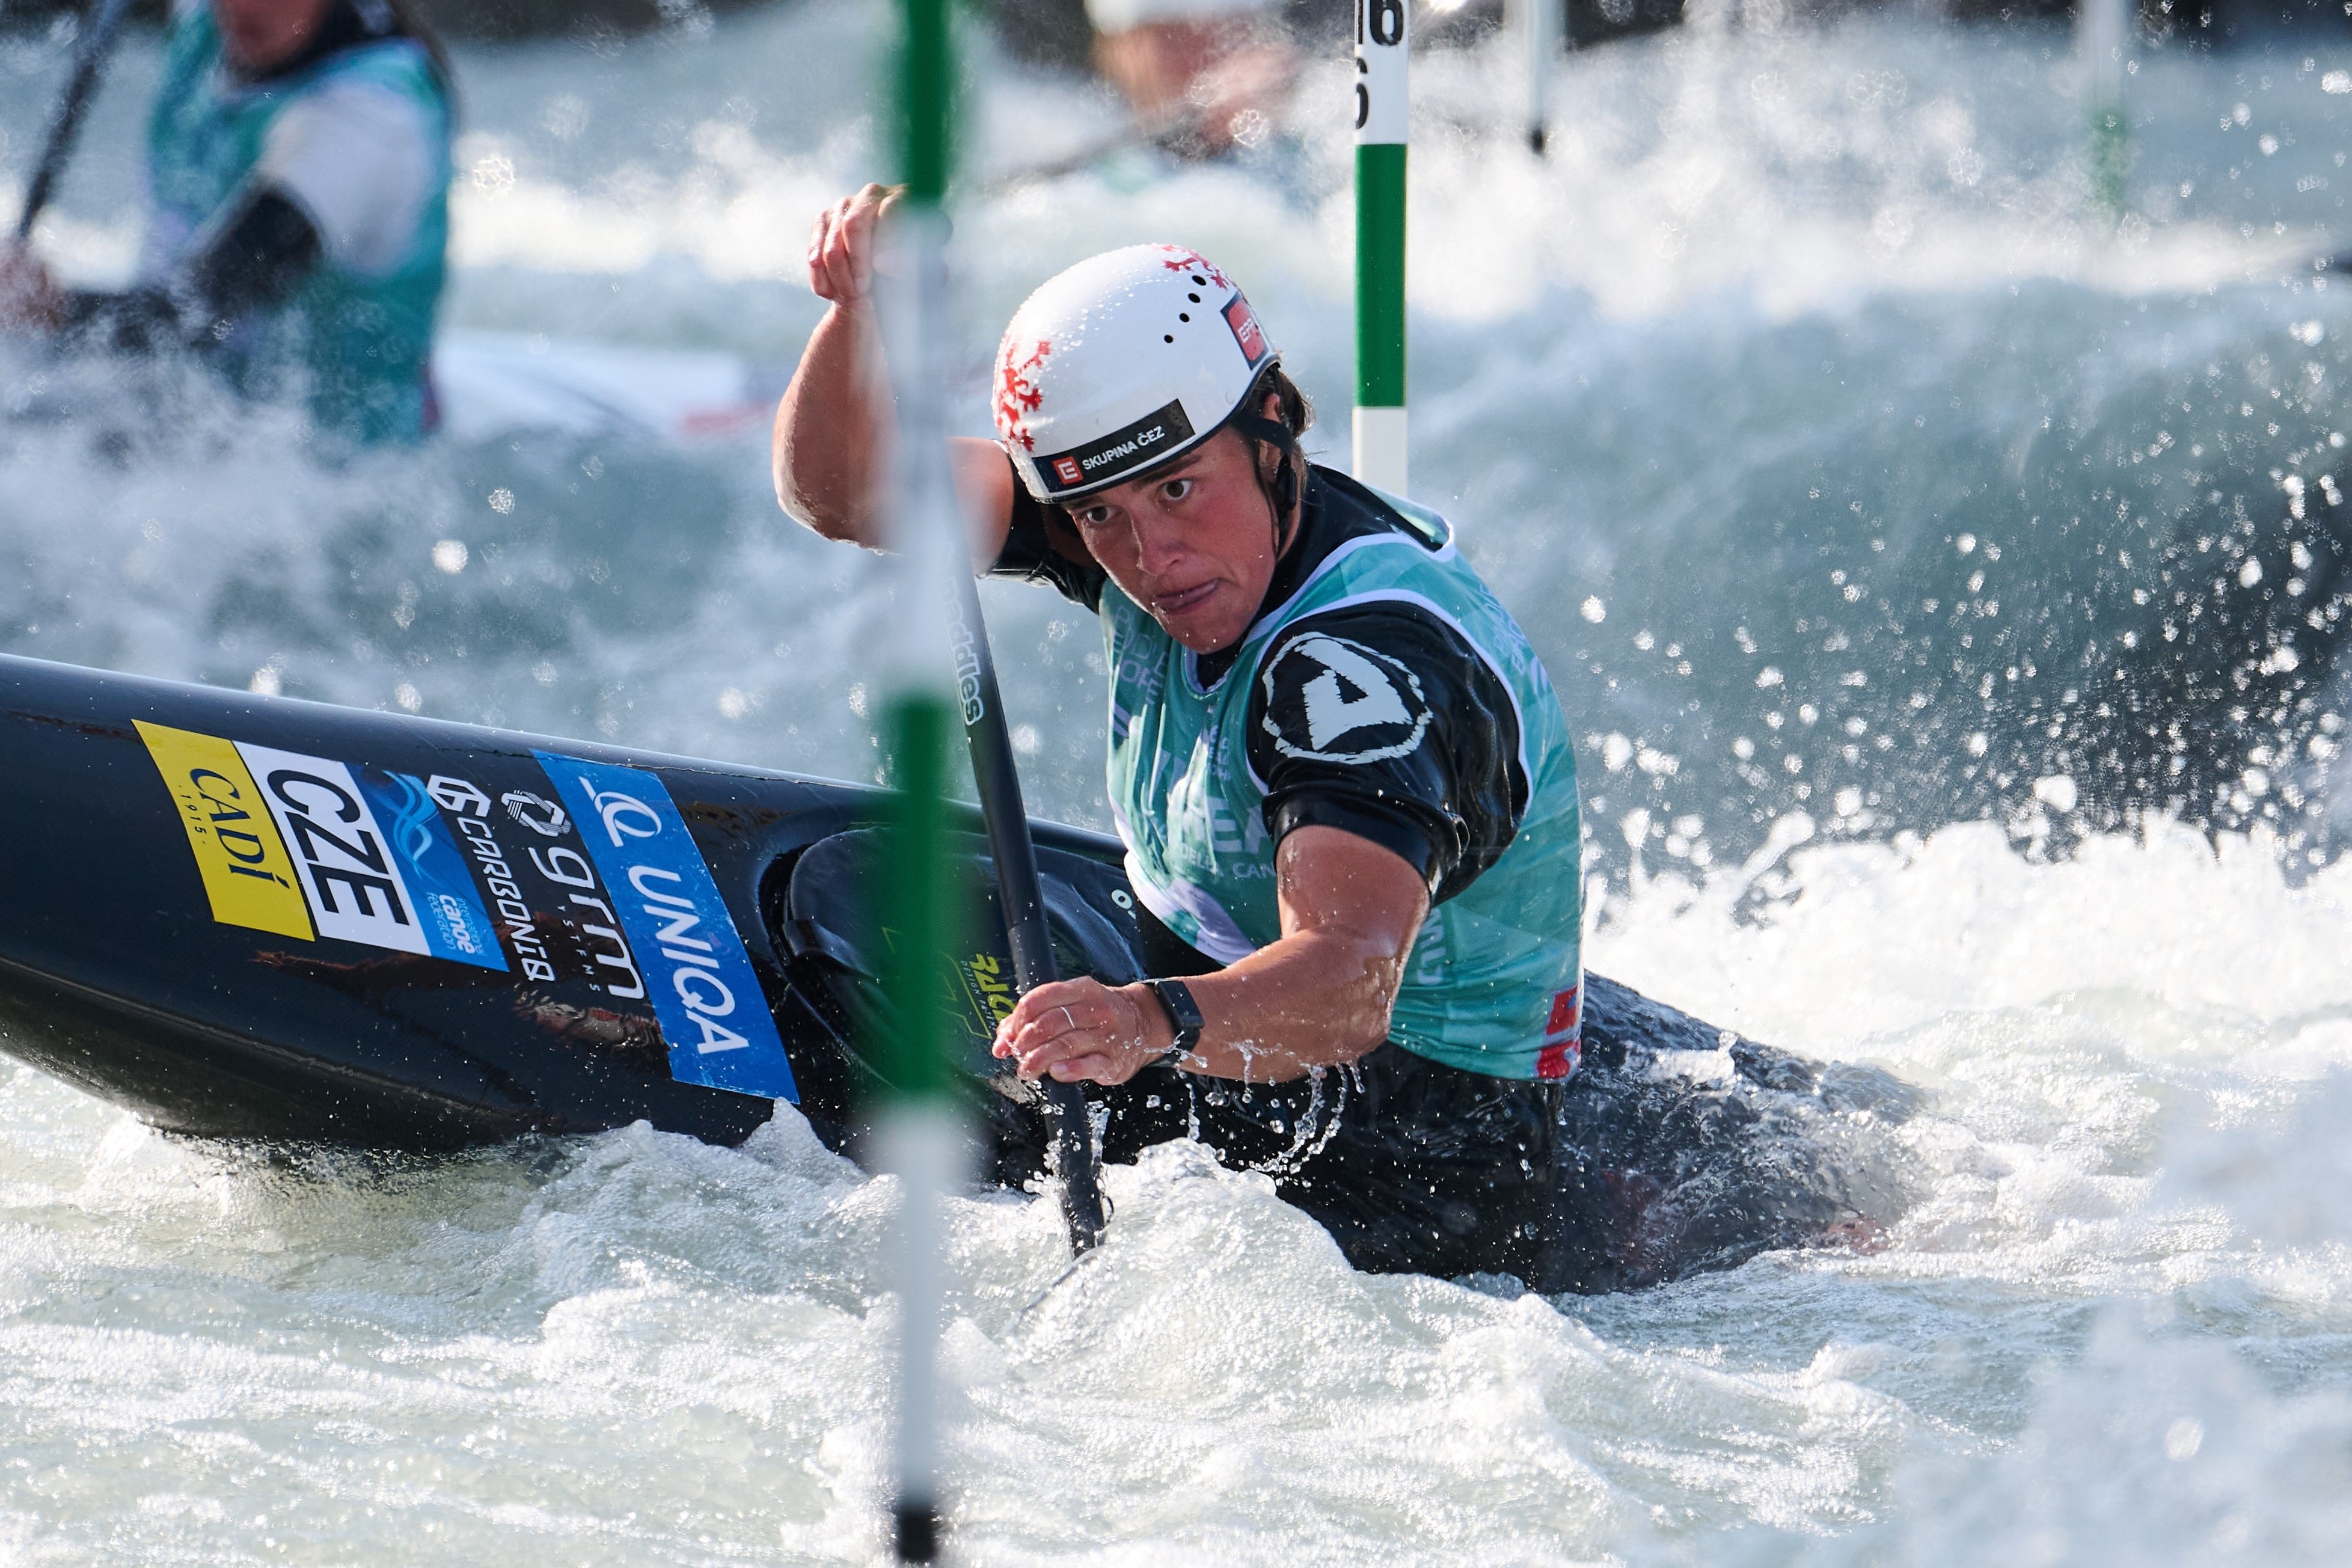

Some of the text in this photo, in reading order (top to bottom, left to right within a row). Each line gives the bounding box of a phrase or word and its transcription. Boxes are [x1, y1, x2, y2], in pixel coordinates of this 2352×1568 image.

[1082, 440, 1139, 470] SKUPINA
[1137, 425, 1165, 446] ČEZ
[180, 794, 207, 835] 1915
[267, 769, 410, 926] CZE
[1232, 861, 1276, 879] CAN
[425, 892, 456, 950] federation
[439, 894, 476, 954] canoe
[455, 897, 488, 956] international
[457, 816, 556, 981] CARBONIQ
[627, 865, 750, 1055] UNIQA
[961, 960, 997, 1031] DESIGN PATEN
